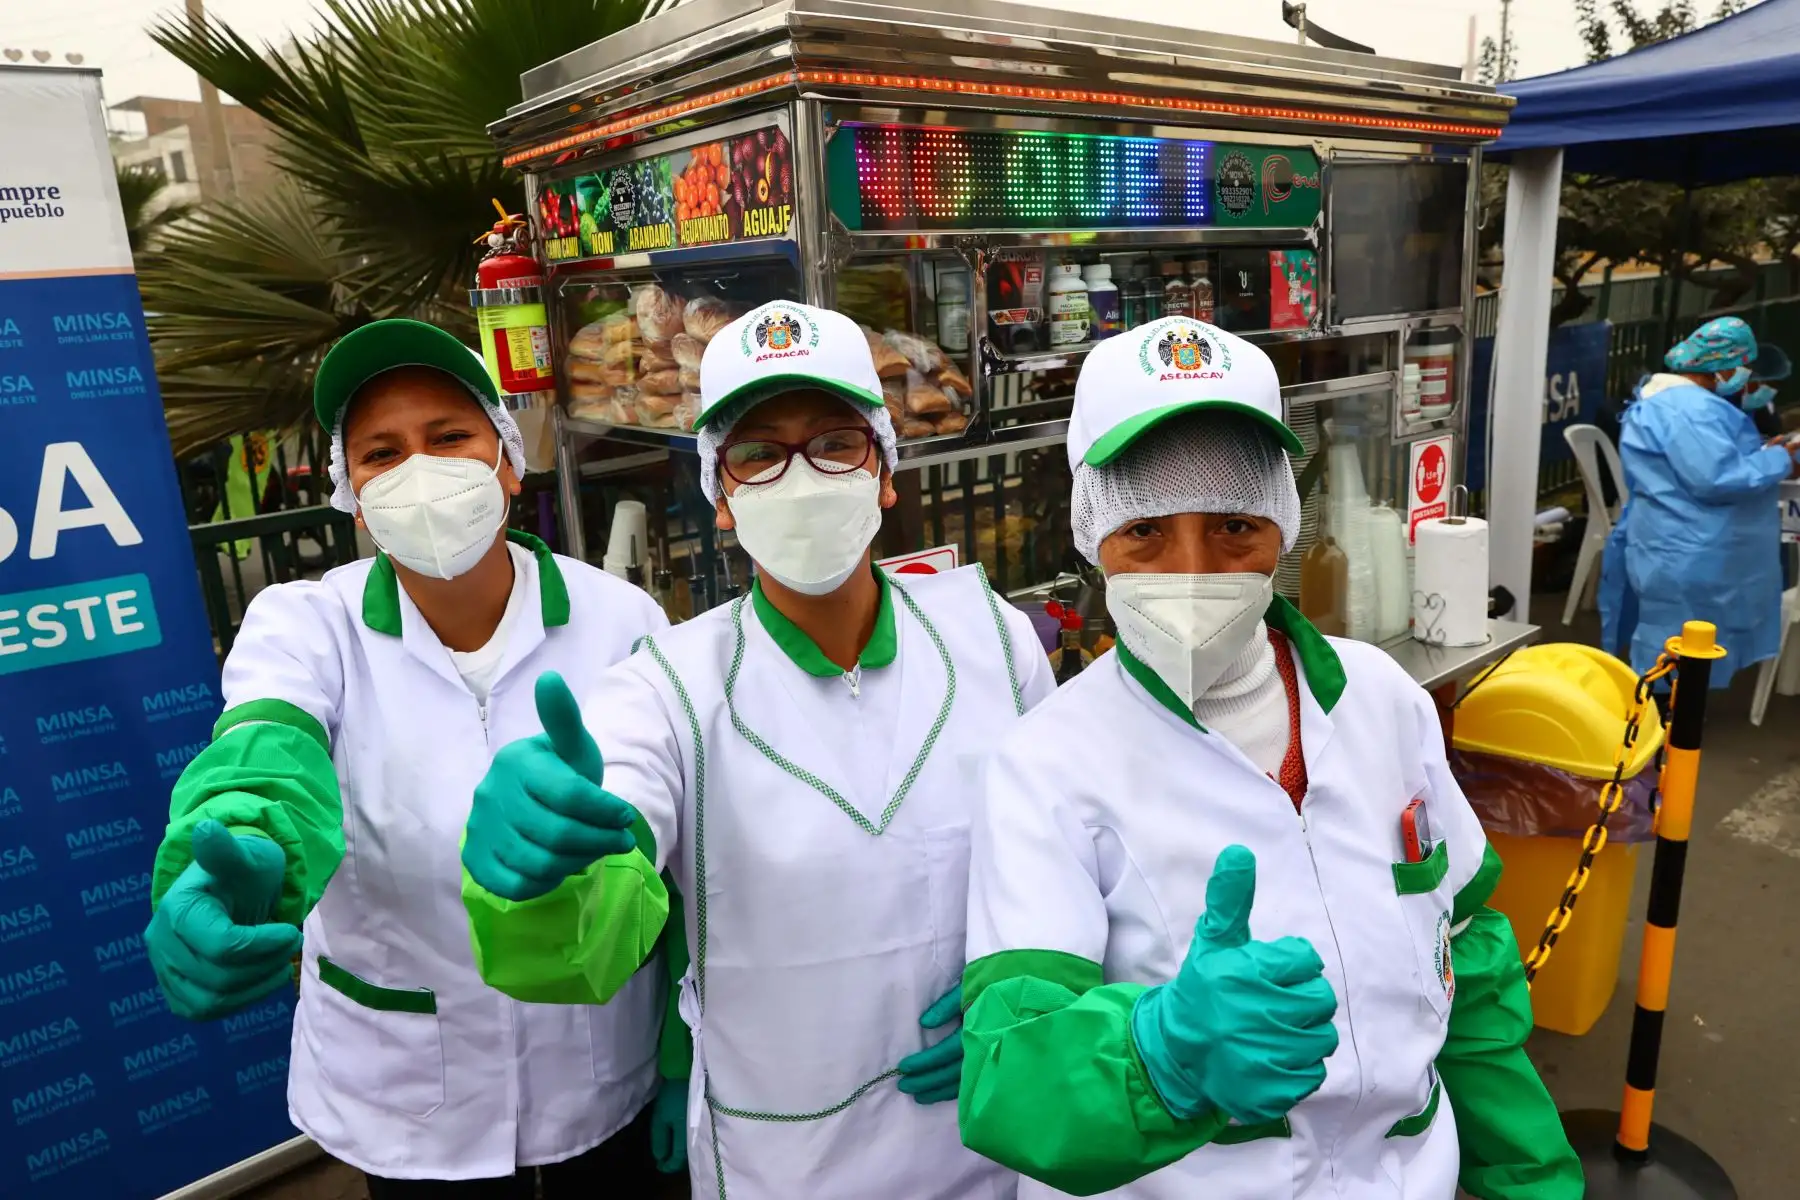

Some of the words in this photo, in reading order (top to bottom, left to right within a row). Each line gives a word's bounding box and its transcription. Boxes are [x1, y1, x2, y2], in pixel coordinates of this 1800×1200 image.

[0, 186, 62, 206] mpre
[0, 202, 65, 224] pueblo
[743, 204, 791, 238] AGUAJE
[592, 231, 614, 255] NONI
[629, 223, 672, 251] ARANDANO
[680, 213, 730, 245] AGUAYMANTO
[0, 317, 21, 337] A
[53, 311, 133, 333] MINSA
[0, 375, 35, 394] SA
[66, 366, 145, 389] MINSA
[0, 441, 144, 563] A
[0, 589, 145, 656] ESTE
[142, 682, 213, 712] MINSA
[35, 703, 115, 734] MINSA
[51, 760, 129, 791] MINSA
[65, 816, 143, 850] MINSA
[0, 844, 36, 869] SA
[93, 932, 148, 962] MIN
[222, 1001, 290, 1034] MINSA
[0, 1016, 81, 1058] MINSA
[124, 1033, 197, 1072] MINSA
[12, 1072, 95, 1115] MINSA
[137, 1086, 210, 1125] MINSA
[26, 1127, 109, 1171] MINSA
